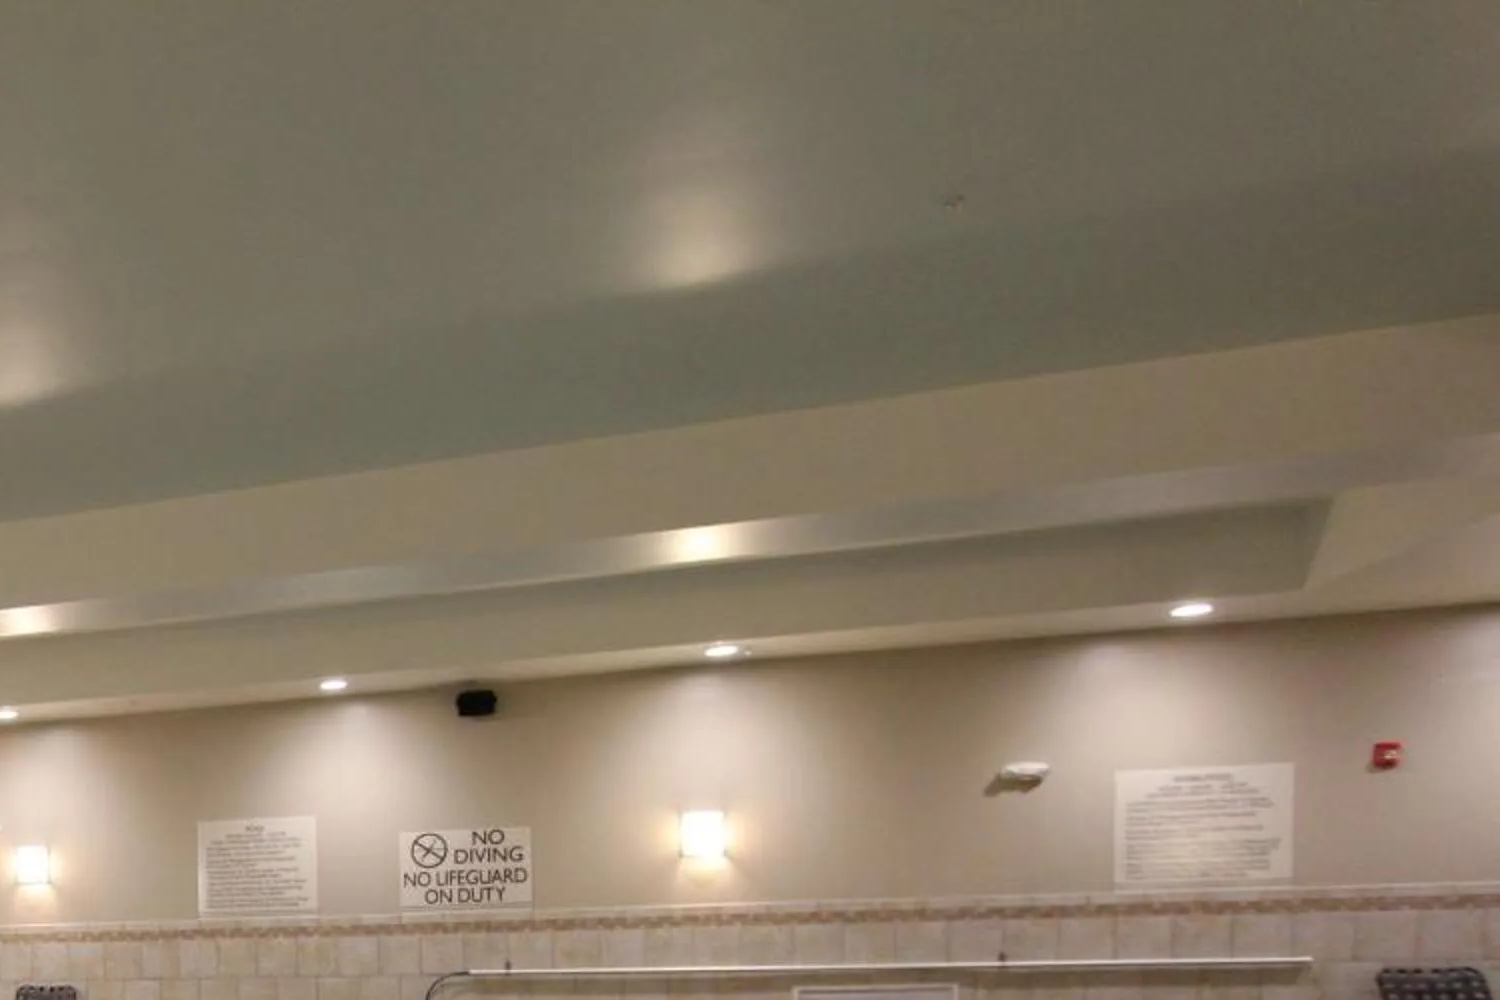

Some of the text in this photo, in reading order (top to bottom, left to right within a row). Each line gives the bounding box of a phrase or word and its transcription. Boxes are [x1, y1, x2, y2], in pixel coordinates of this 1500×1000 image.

[471, 829, 505, 845] NO
[453, 845, 524, 864] DIVING
[403, 867, 528, 888] NO LIFEGUARD
[424, 886, 506, 904] ON DUTY
